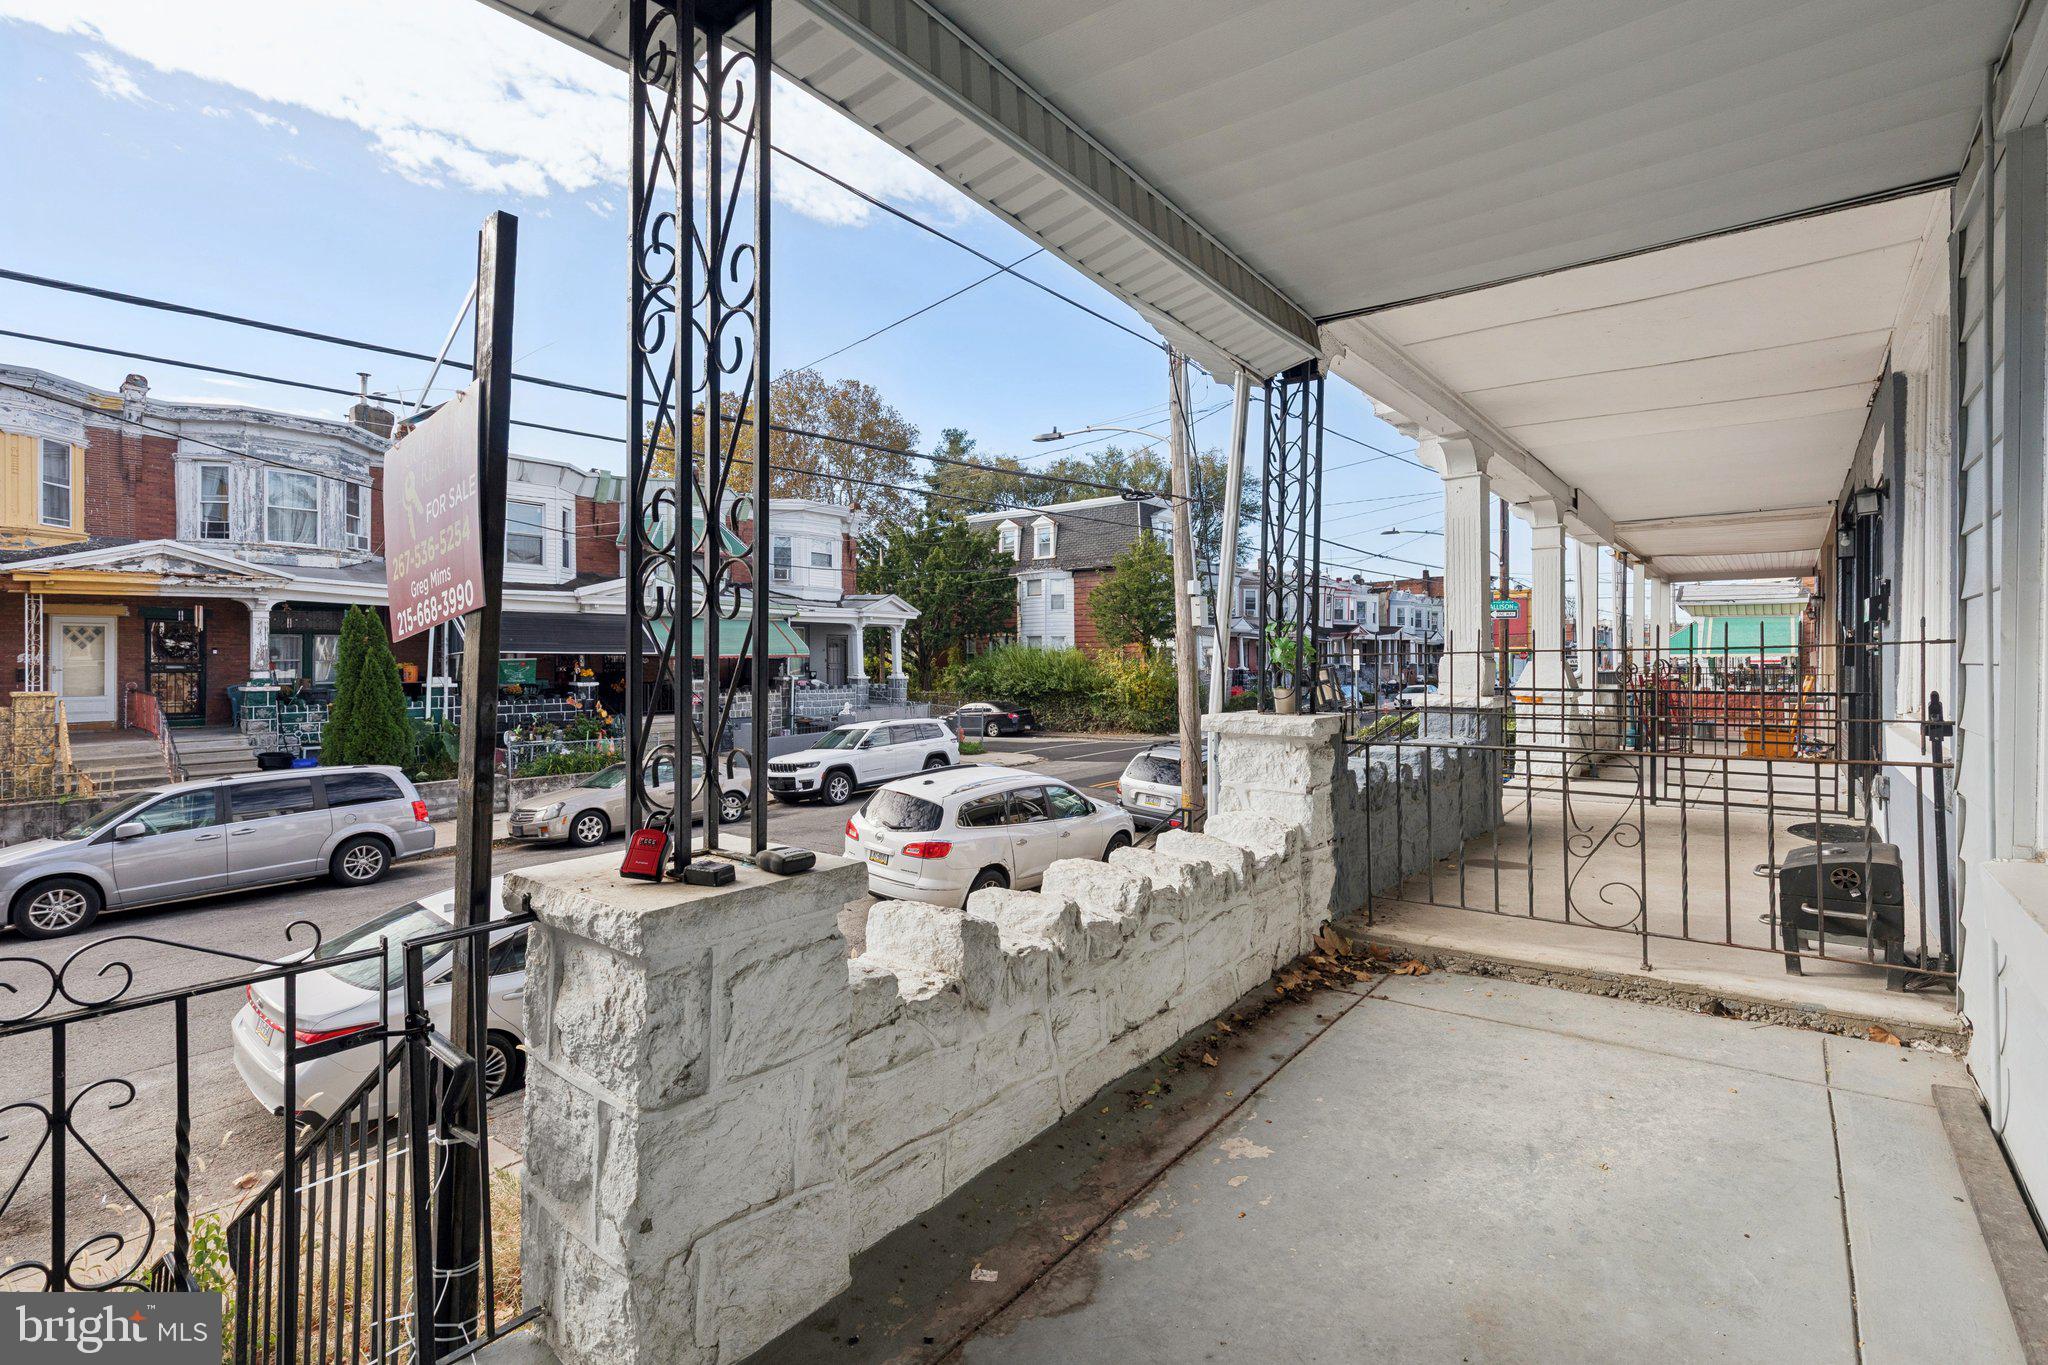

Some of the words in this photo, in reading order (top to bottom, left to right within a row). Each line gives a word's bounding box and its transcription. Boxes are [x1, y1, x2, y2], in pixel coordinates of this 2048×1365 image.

[426, 493, 446, 524] FOR
[449, 473, 476, 508] SALE
[393, 514, 470, 581] 267-536-5254
[397, 579, 474, 636] 215-668-3990
[411, 579, 428, 598] Greg
[430, 567, 451, 589] Mims
